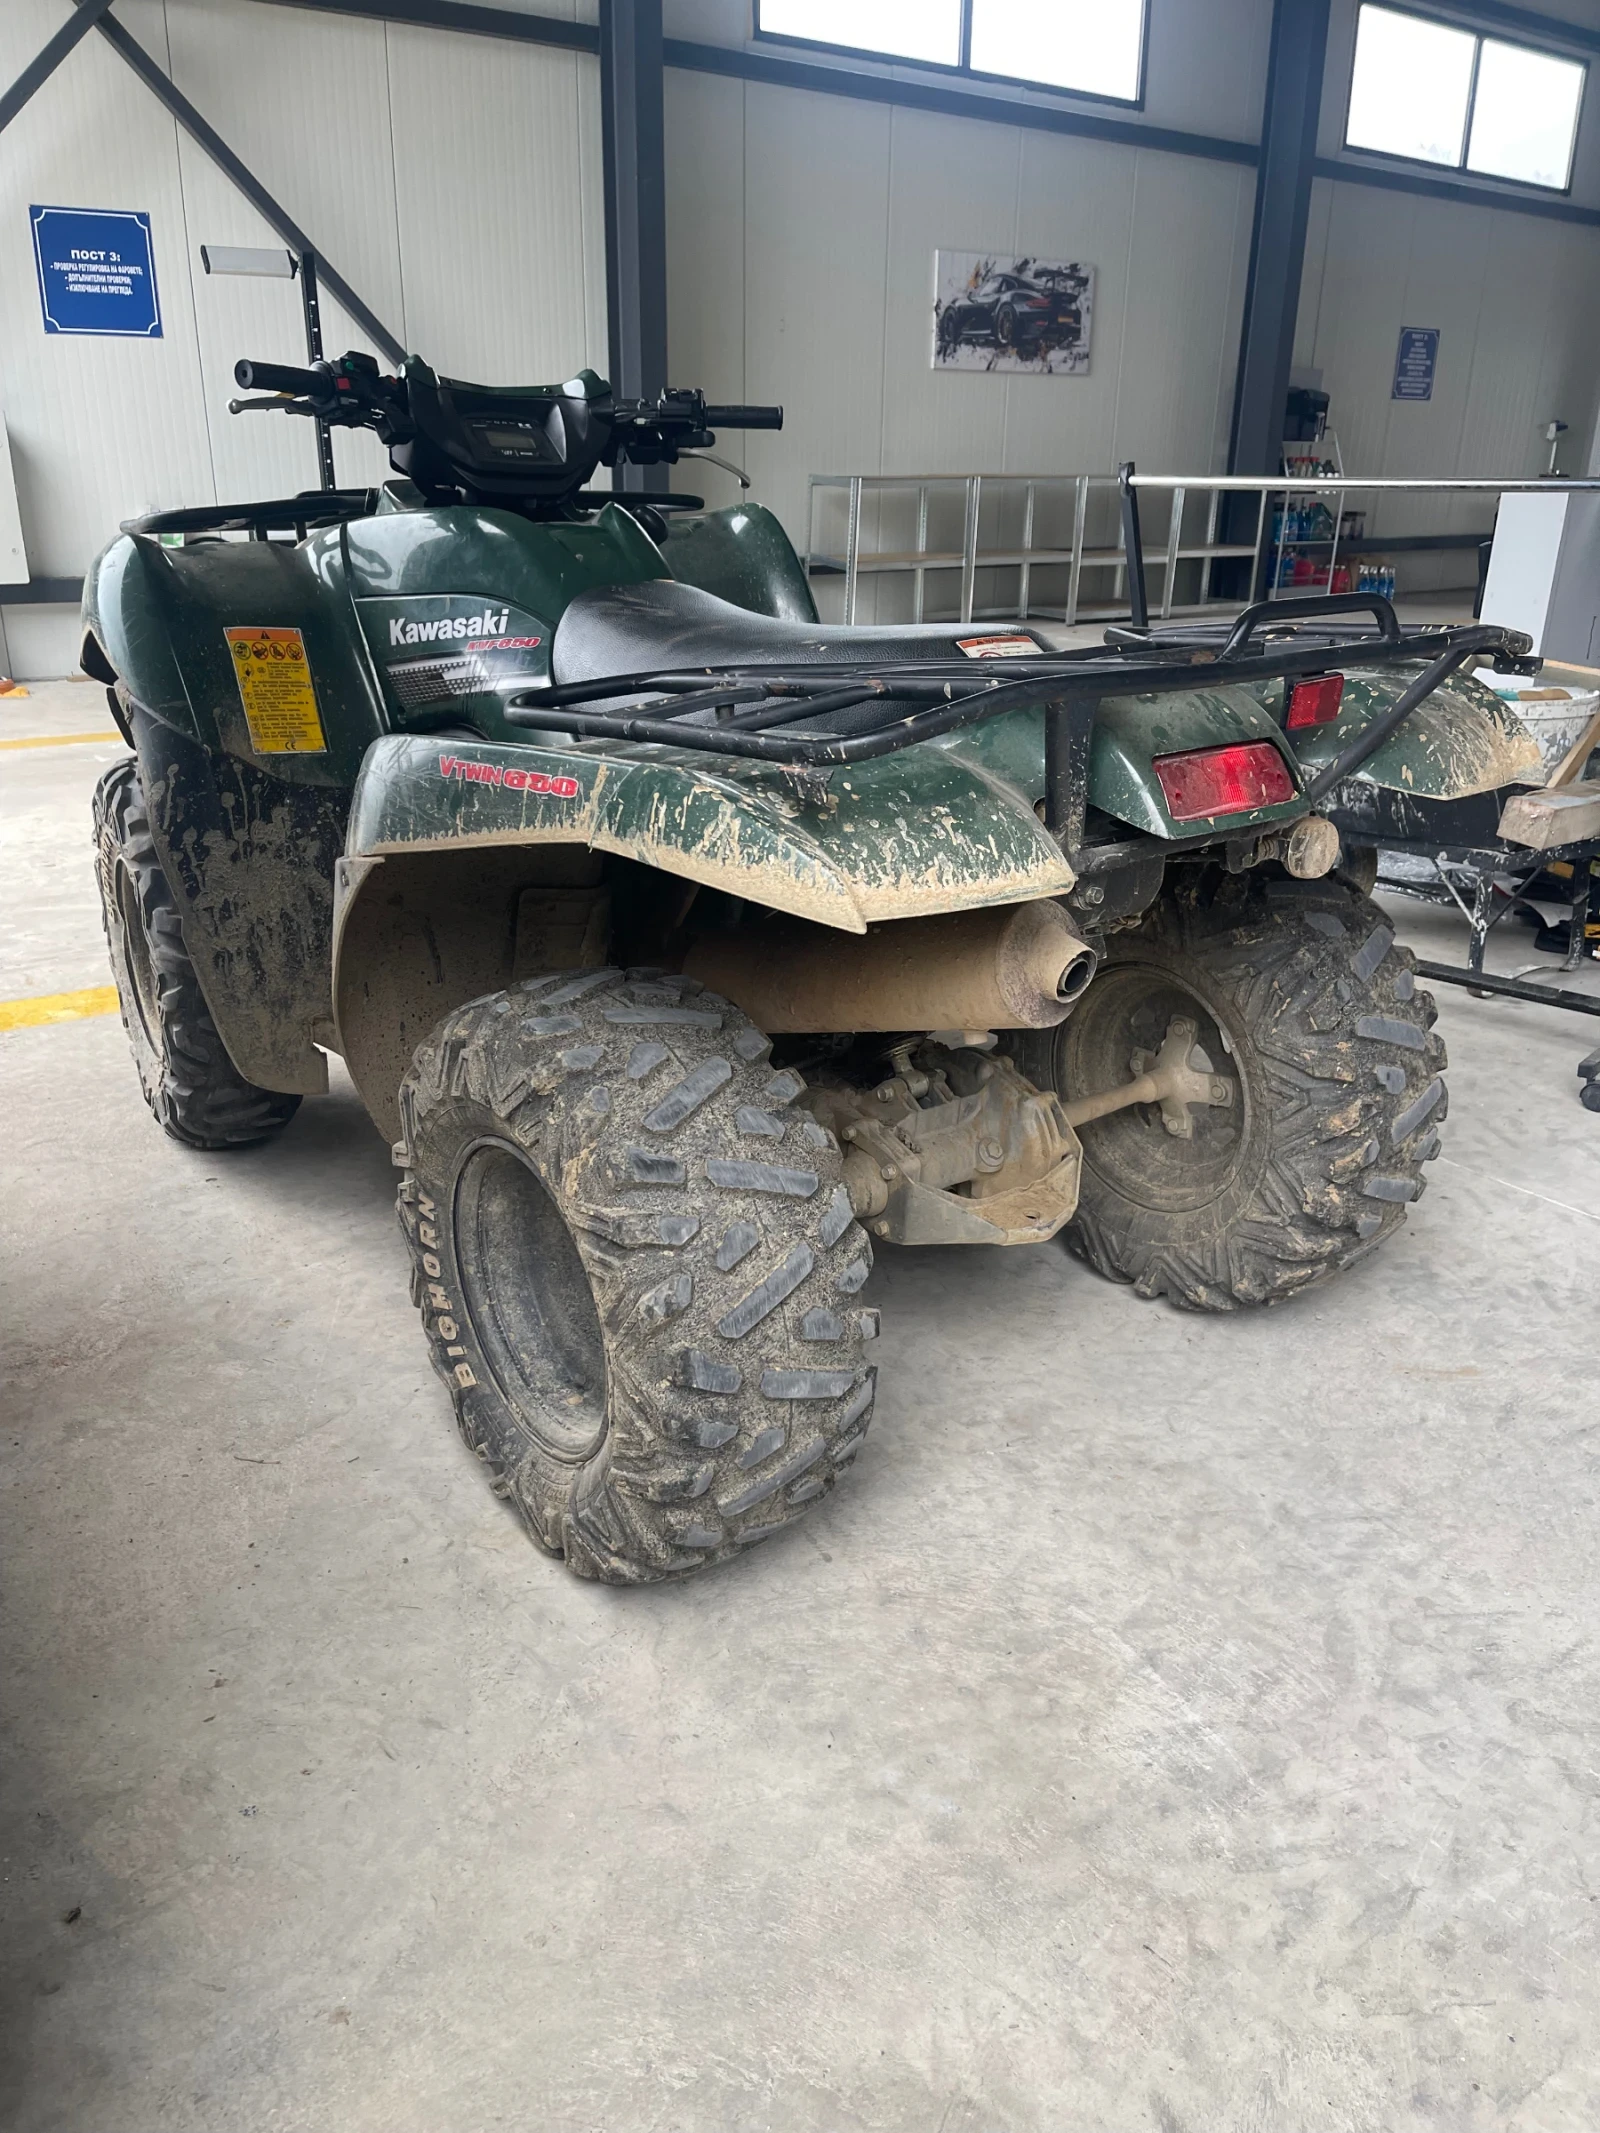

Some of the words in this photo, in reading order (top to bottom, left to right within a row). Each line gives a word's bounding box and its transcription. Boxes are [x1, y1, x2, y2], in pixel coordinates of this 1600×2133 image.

[71, 250, 105, 261] ПОСТ
[109, 252, 121, 262] 3:
[53, 262, 78, 271] ПРОВЕРКА
[78, 263, 110, 273] РЕГУЛИРОВКА
[110, 264, 118, 273] НА
[68, 273, 106, 283] ДОПЪЛНИТЕЛНИ
[101, 285, 108, 293] НА
[389, 608, 510, 646] Kawasaki
[465, 636, 541, 652] KVF650
[418, 1193, 478, 1388] BIGHORN
